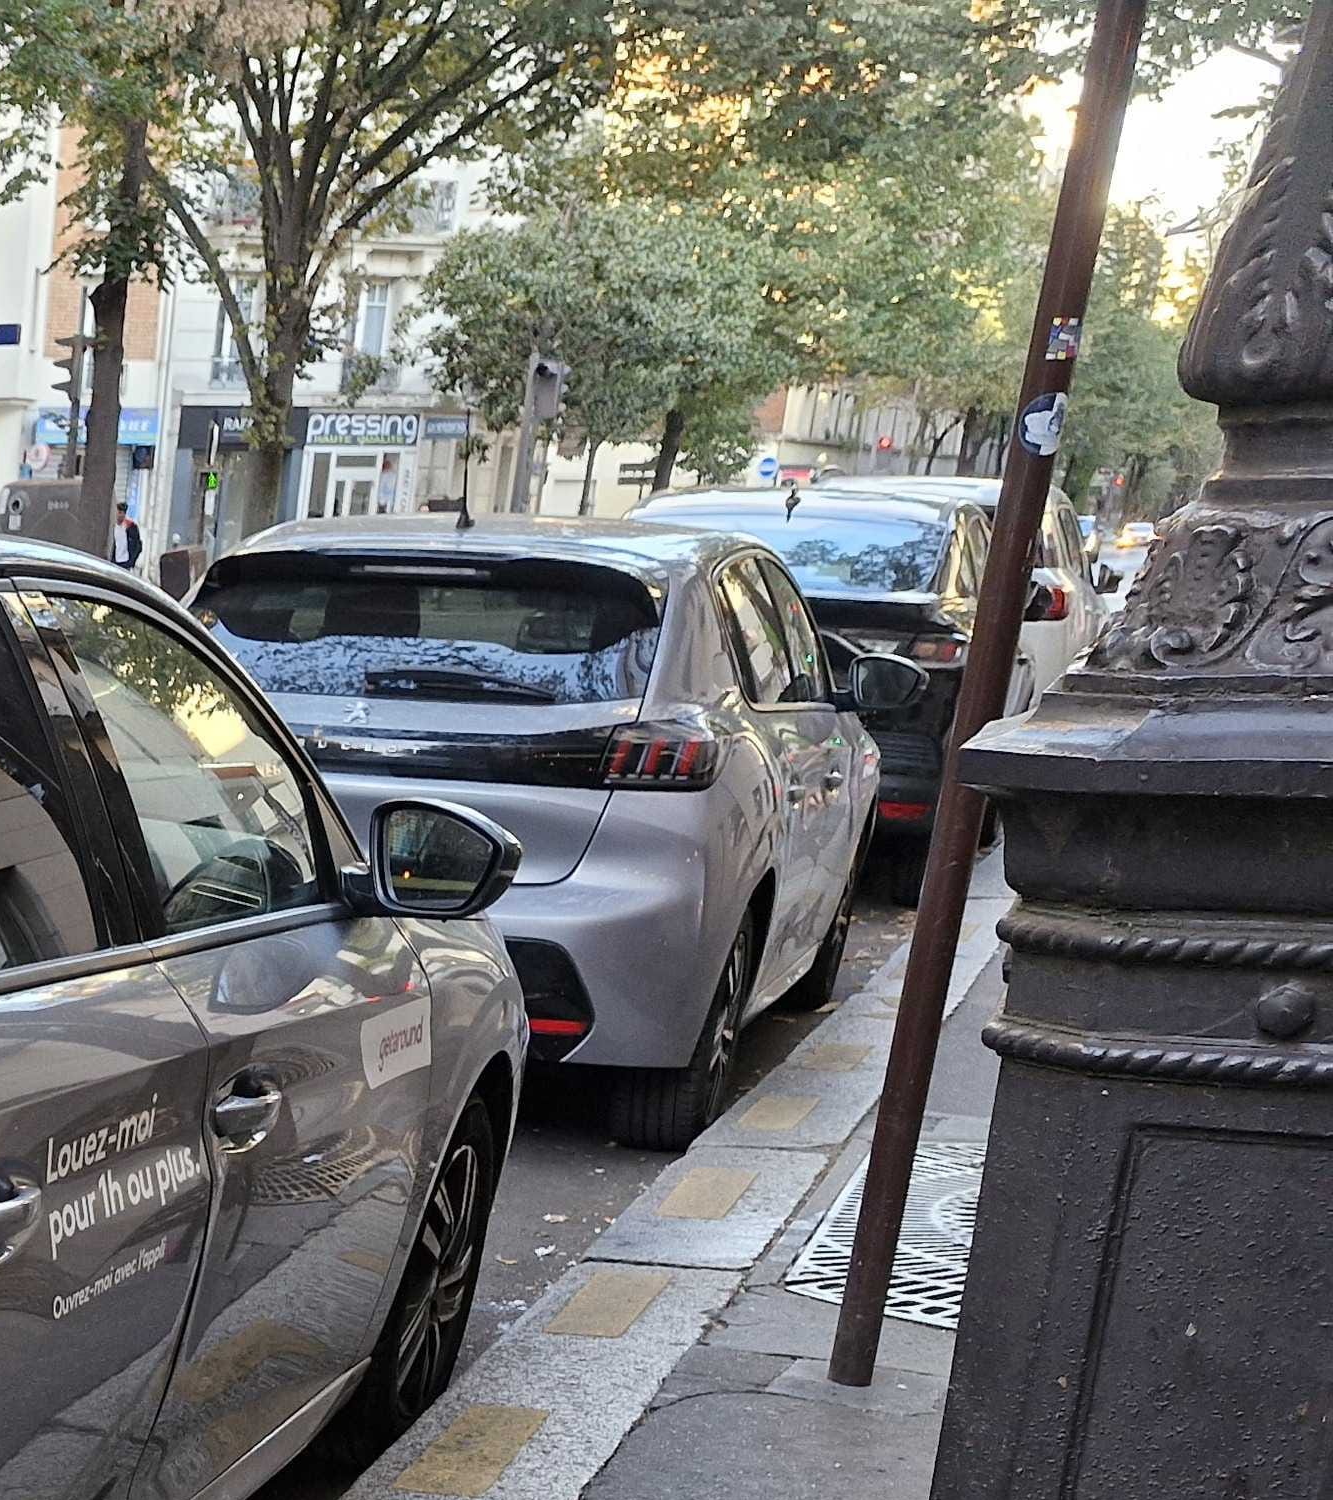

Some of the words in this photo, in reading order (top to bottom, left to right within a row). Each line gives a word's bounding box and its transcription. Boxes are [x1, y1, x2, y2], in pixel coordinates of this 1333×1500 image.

[306, 413, 420, 444] pressing
[46, 1092, 158, 1184] Louez-moi
[48, 1191, 96, 1261] pour
[98, 1169, 125, 1218] 1h
[127, 1166, 154, 1205] ou
[160, 1147, 201, 1206] plus.
[53, 1266, 114, 1319] Ouvrez-moi
[114, 1258, 137, 1284] avec
